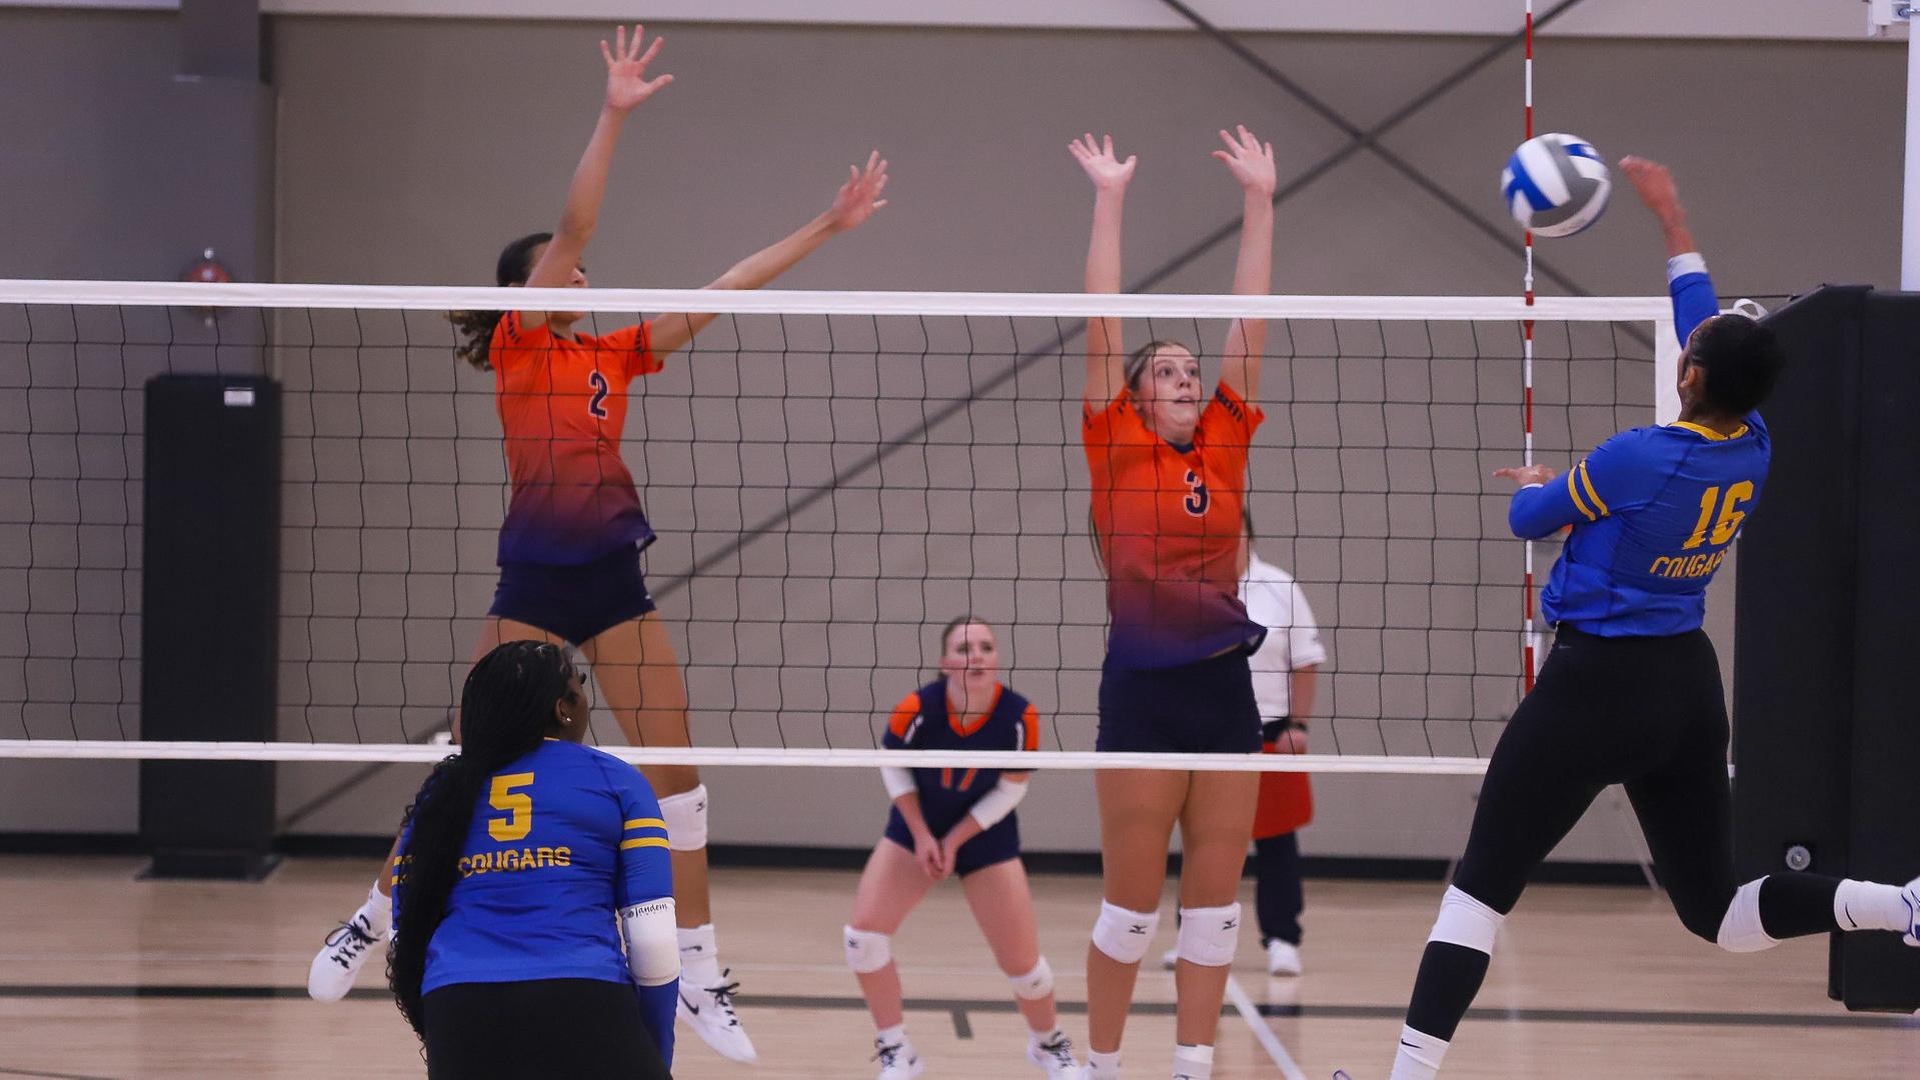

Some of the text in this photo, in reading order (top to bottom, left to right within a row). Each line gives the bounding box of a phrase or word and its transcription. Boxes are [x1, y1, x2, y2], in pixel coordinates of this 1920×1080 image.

[588, 369, 608, 420] 2
[1183, 468, 1211, 517] 3
[1682, 480, 1754, 550] 16
[1649, 547, 1729, 577] COUGAR
[488, 772, 535, 842] 5
[458, 846, 571, 878] COUGARS
